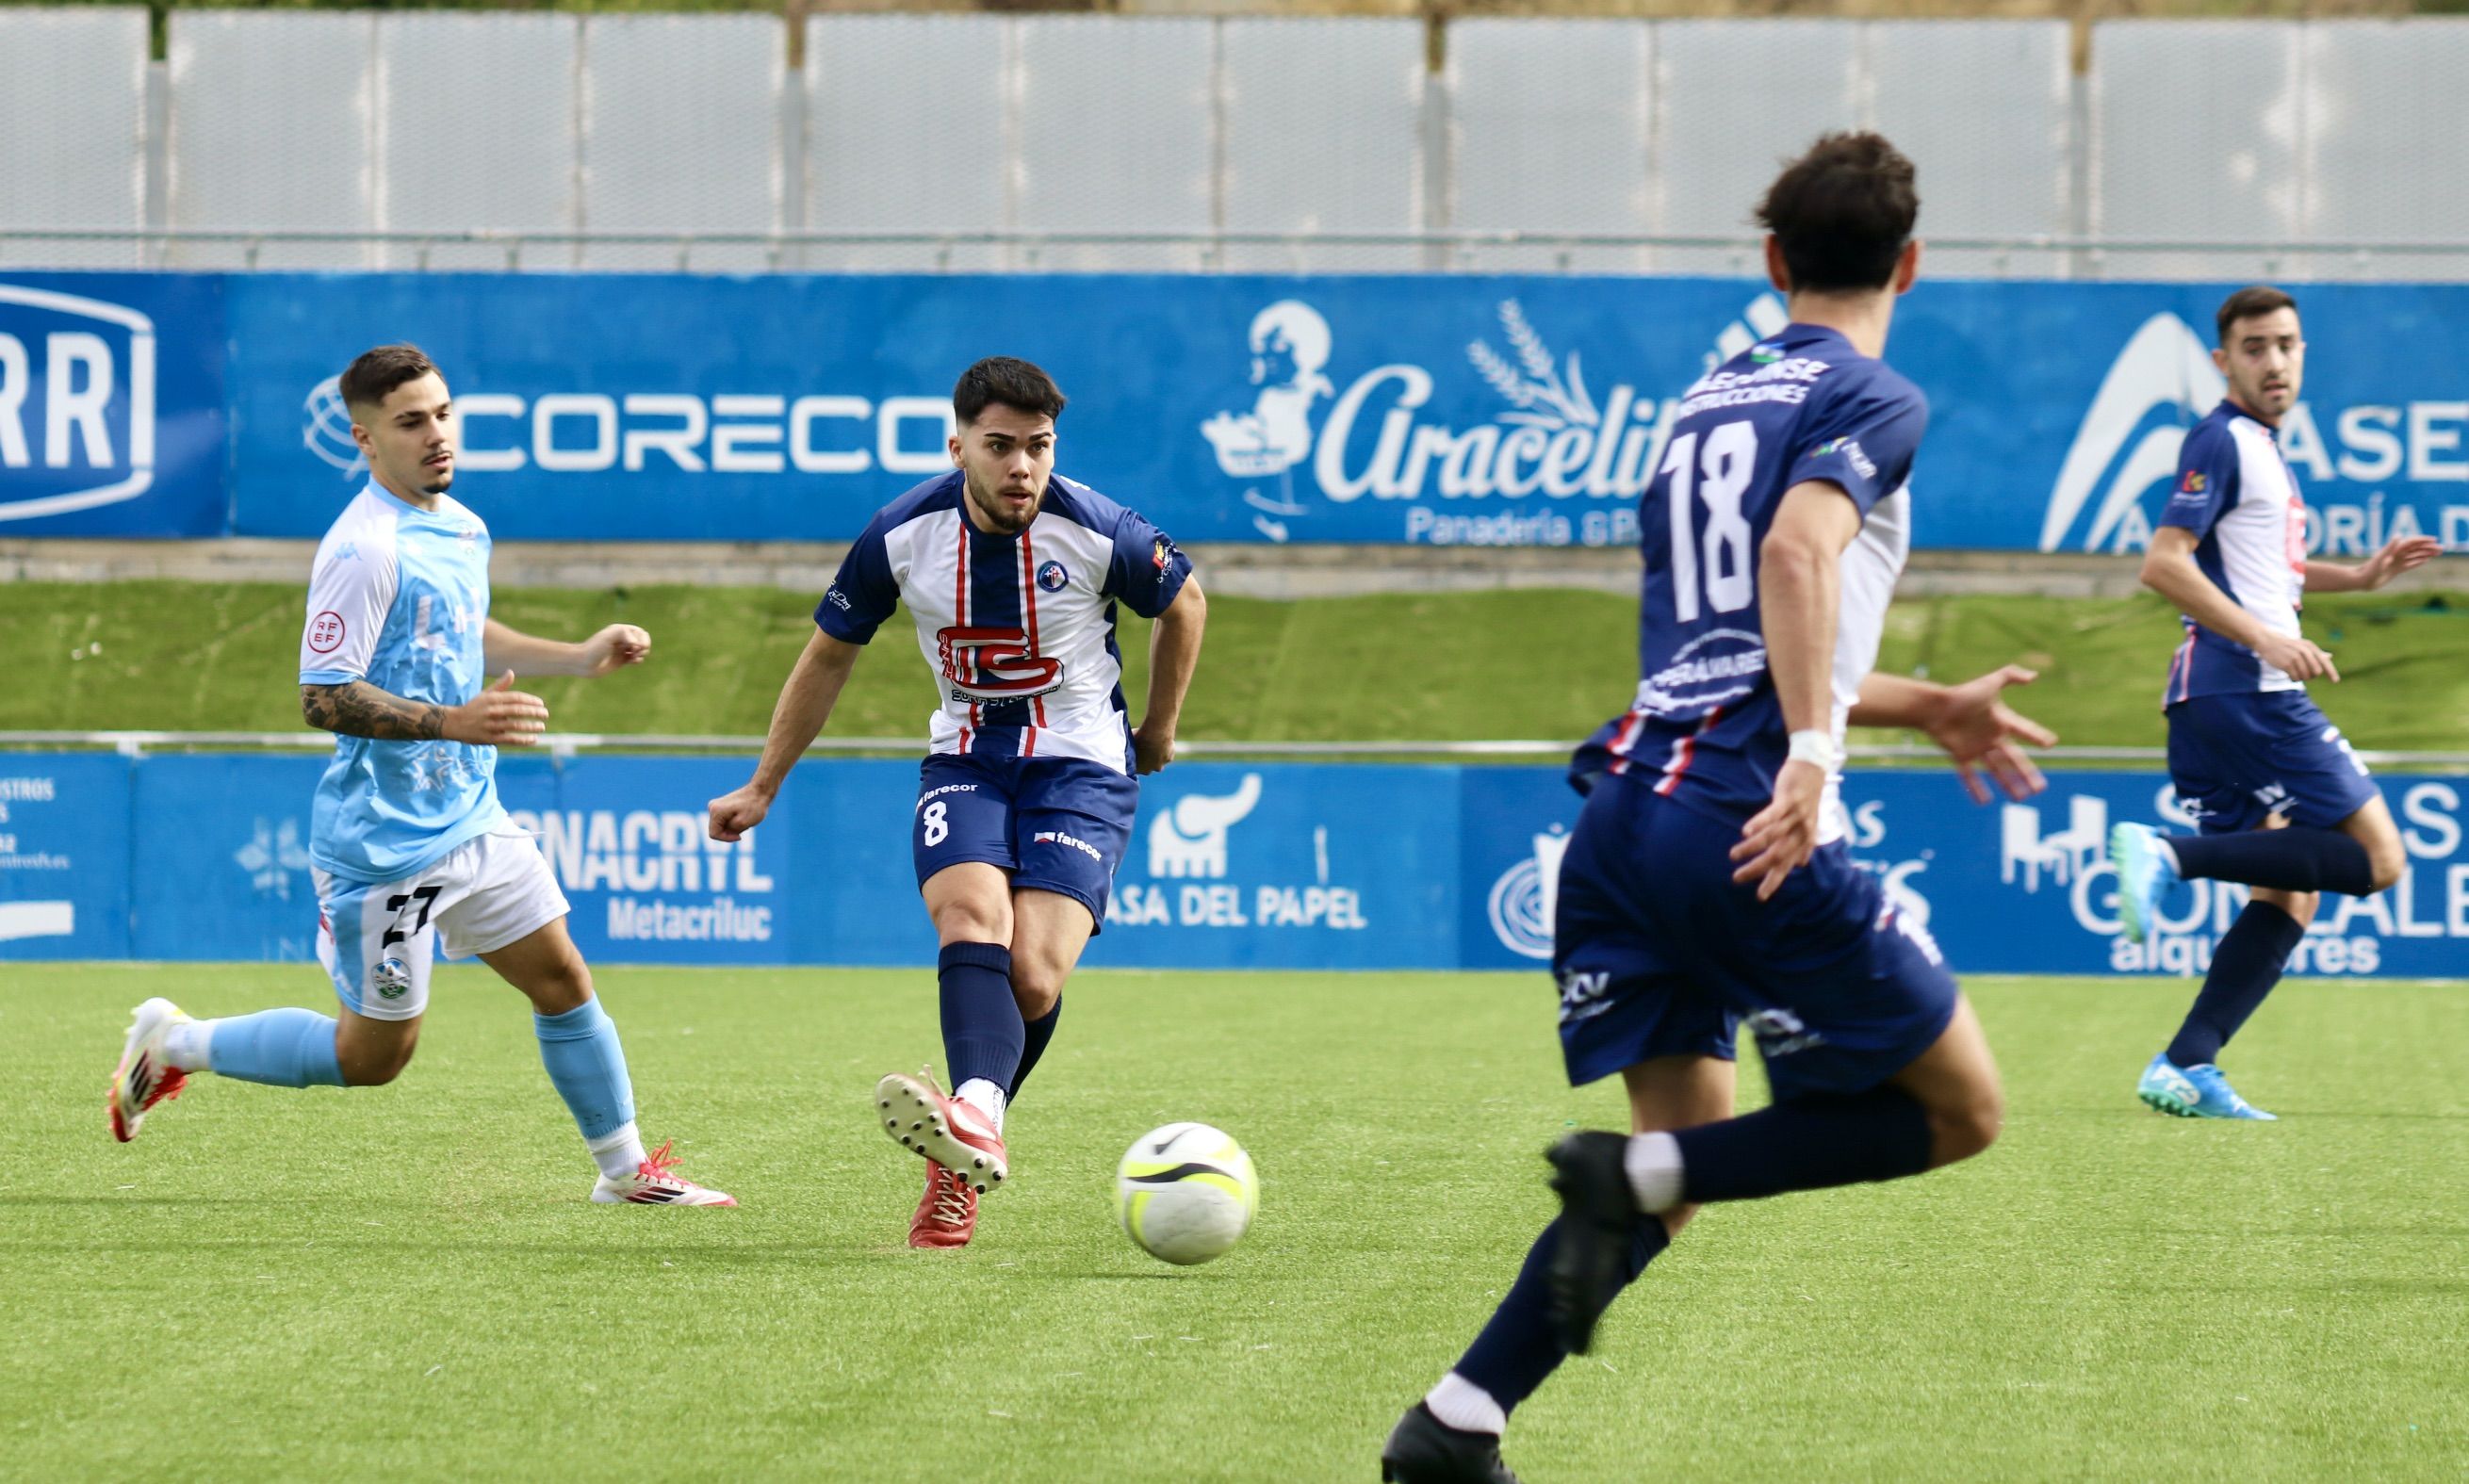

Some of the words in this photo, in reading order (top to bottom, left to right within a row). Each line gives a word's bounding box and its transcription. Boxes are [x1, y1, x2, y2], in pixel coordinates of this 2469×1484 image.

[452, 393, 956, 473] CORECO
[1660, 419, 1758, 623] 18
[924, 784, 978, 802] farecor
[924, 801, 949, 847] 8
[1056, 831, 1102, 862] farecor
[382, 886, 443, 950] 27
[608, 896, 773, 941] Metacriluc
[1104, 885, 1171, 926] ASA
[1180, 884, 1249, 926] DEL
[1256, 885, 1369, 929] PAPEL
